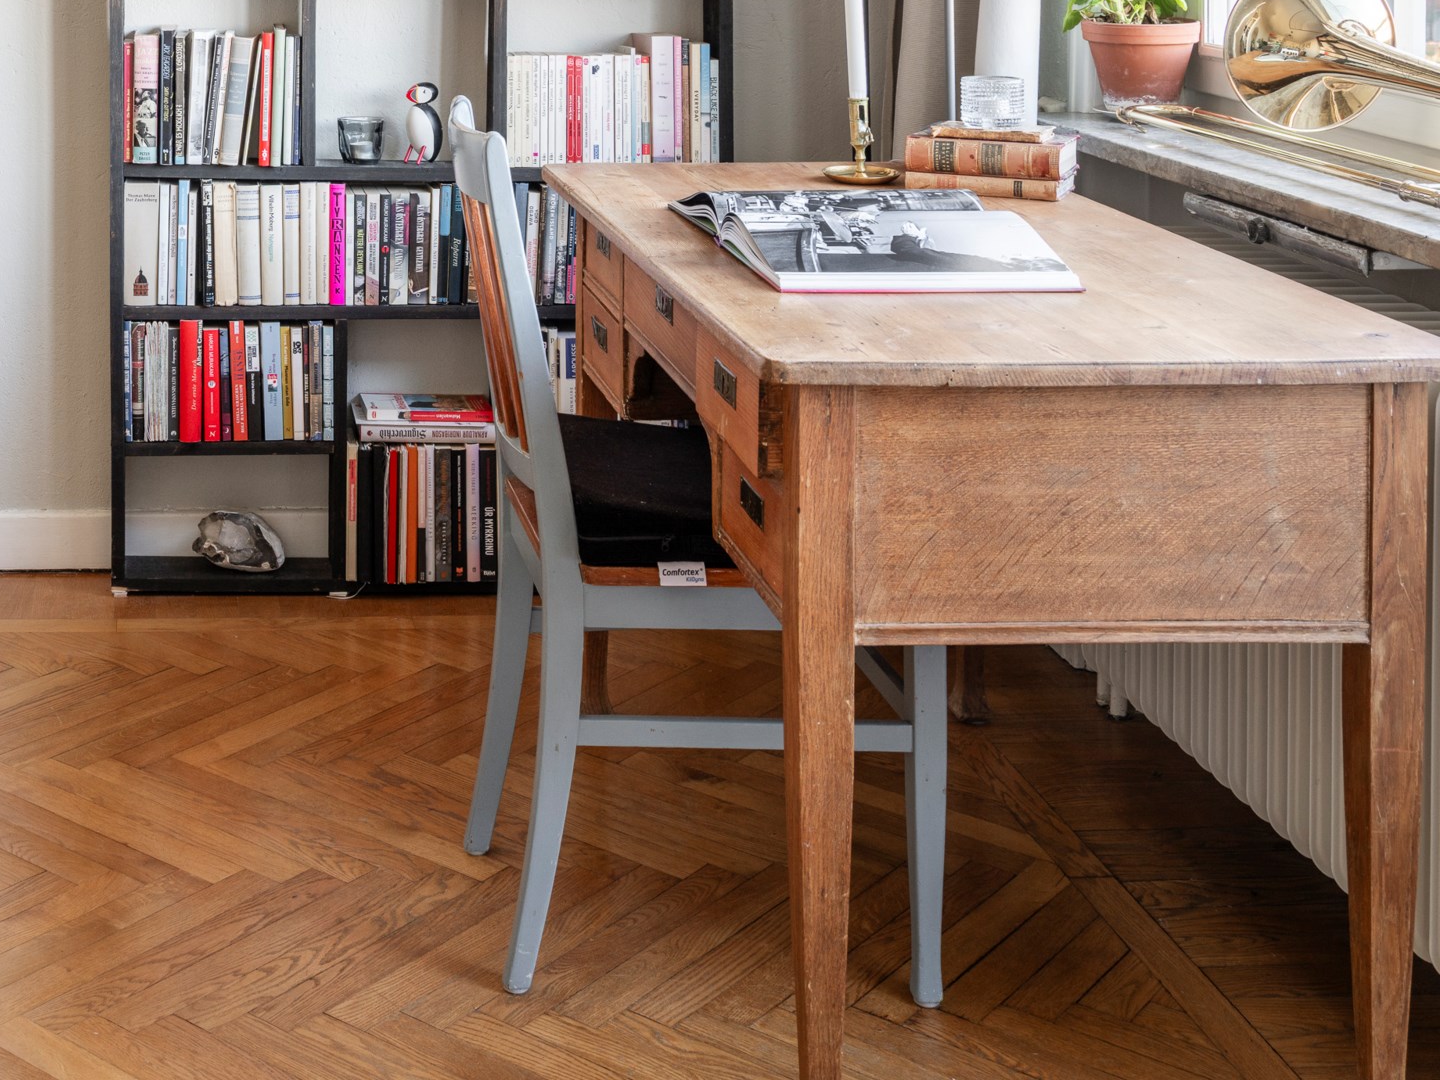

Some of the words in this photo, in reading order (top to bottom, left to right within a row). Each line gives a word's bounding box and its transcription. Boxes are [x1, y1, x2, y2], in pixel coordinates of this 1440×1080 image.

[710, 113, 717, 122] ME
[396, 199, 404, 212] KLAS
[395, 213, 405, 245] ÖSTERGREN
[451, 238, 461, 267] Roparen
[484, 507, 495, 517] ÚR
[485, 518, 493, 555] MYRKRINU
